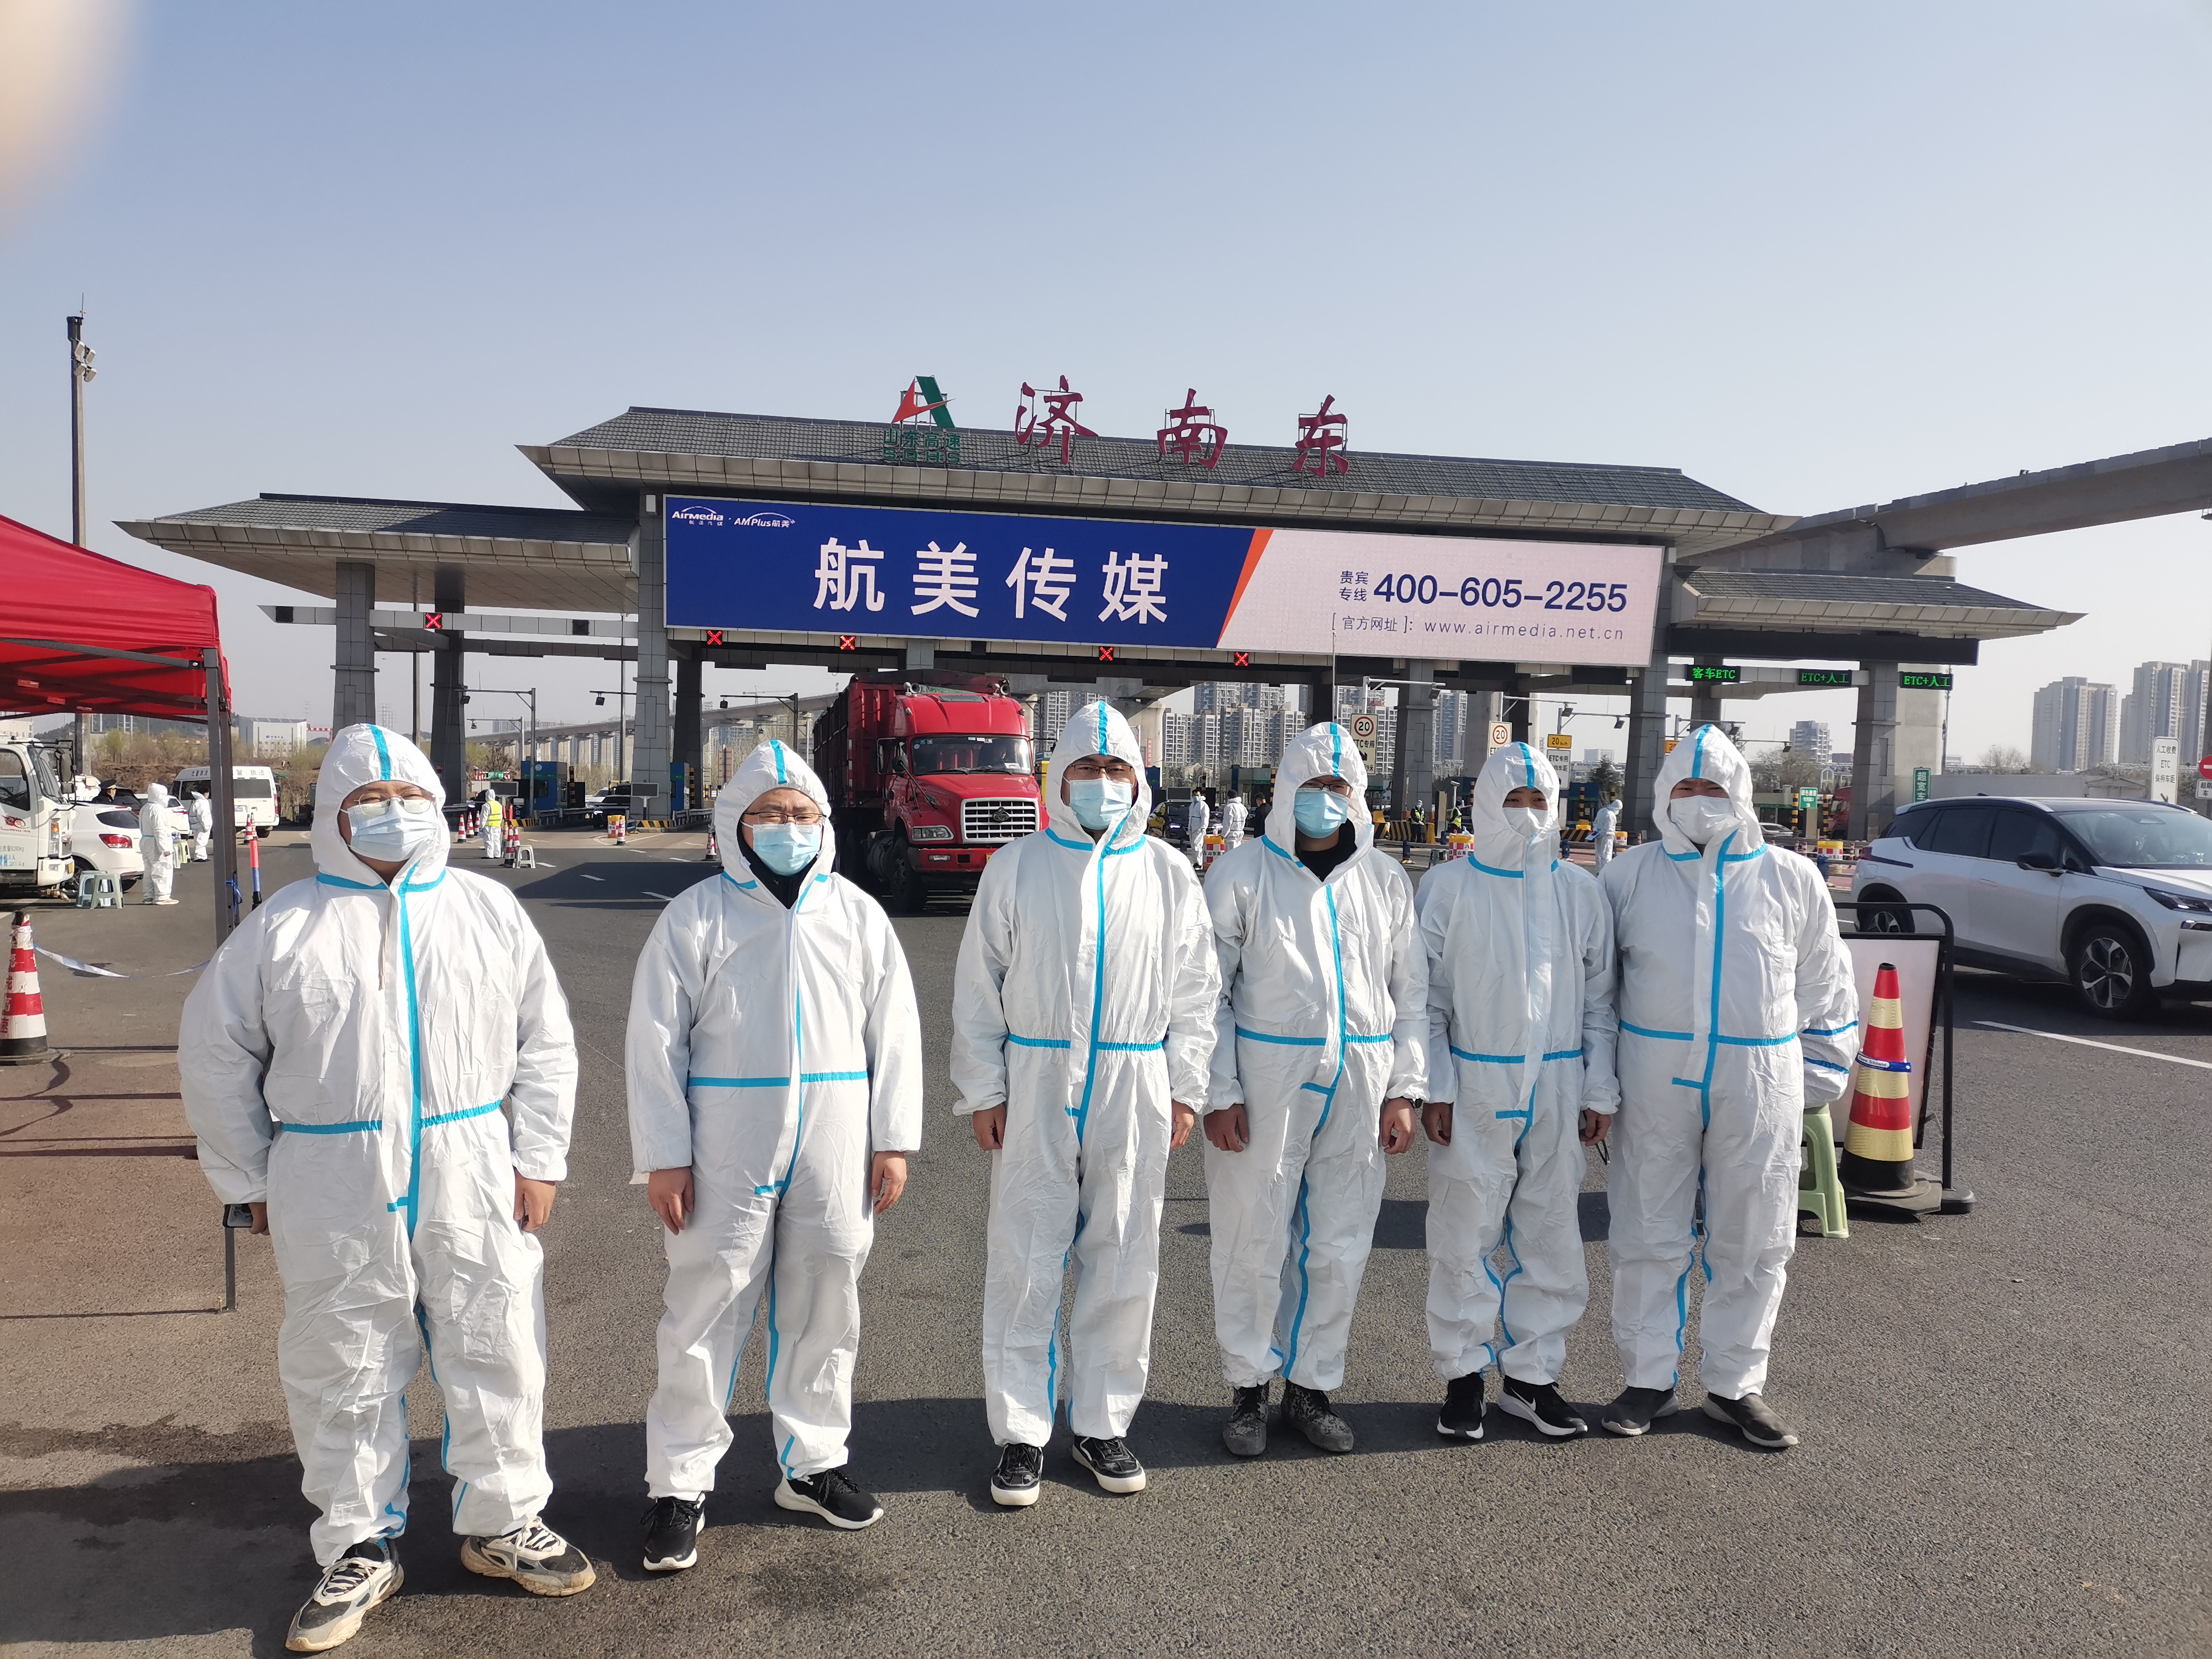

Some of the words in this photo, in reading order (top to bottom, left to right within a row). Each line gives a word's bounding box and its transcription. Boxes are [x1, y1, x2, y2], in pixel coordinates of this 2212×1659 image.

[1015, 374, 1349, 478] 济南东
[883, 427, 961, 450] 山东高速
[883, 448, 961, 463] SDHS
[813, 536, 1168, 624] 航美传媒
[1339, 570, 1369, 585] 贵宾
[1339, 587, 1367, 602] 专线
[1373, 573, 1627, 612] 400-605-2255
[1424, 620, 1624, 640] www.airmedia.net.cn
[1692, 666, 1736, 680] 客车ETC
[1801, 672, 1849, 684] ETC+人工
[1903, 675, 1951, 687] ETC+人工
[1358, 721, 1370, 732] 20
[1496, 729, 1505, 739] 20
[1353, 739, 1375, 748] TC专用
[2156, 745, 2177, 754] 人工收费
[2161, 760, 2171, 769] ETC
[1916, 771, 1927, 800] 超宽车
[2155, 774, 2176, 784] 保持车距
